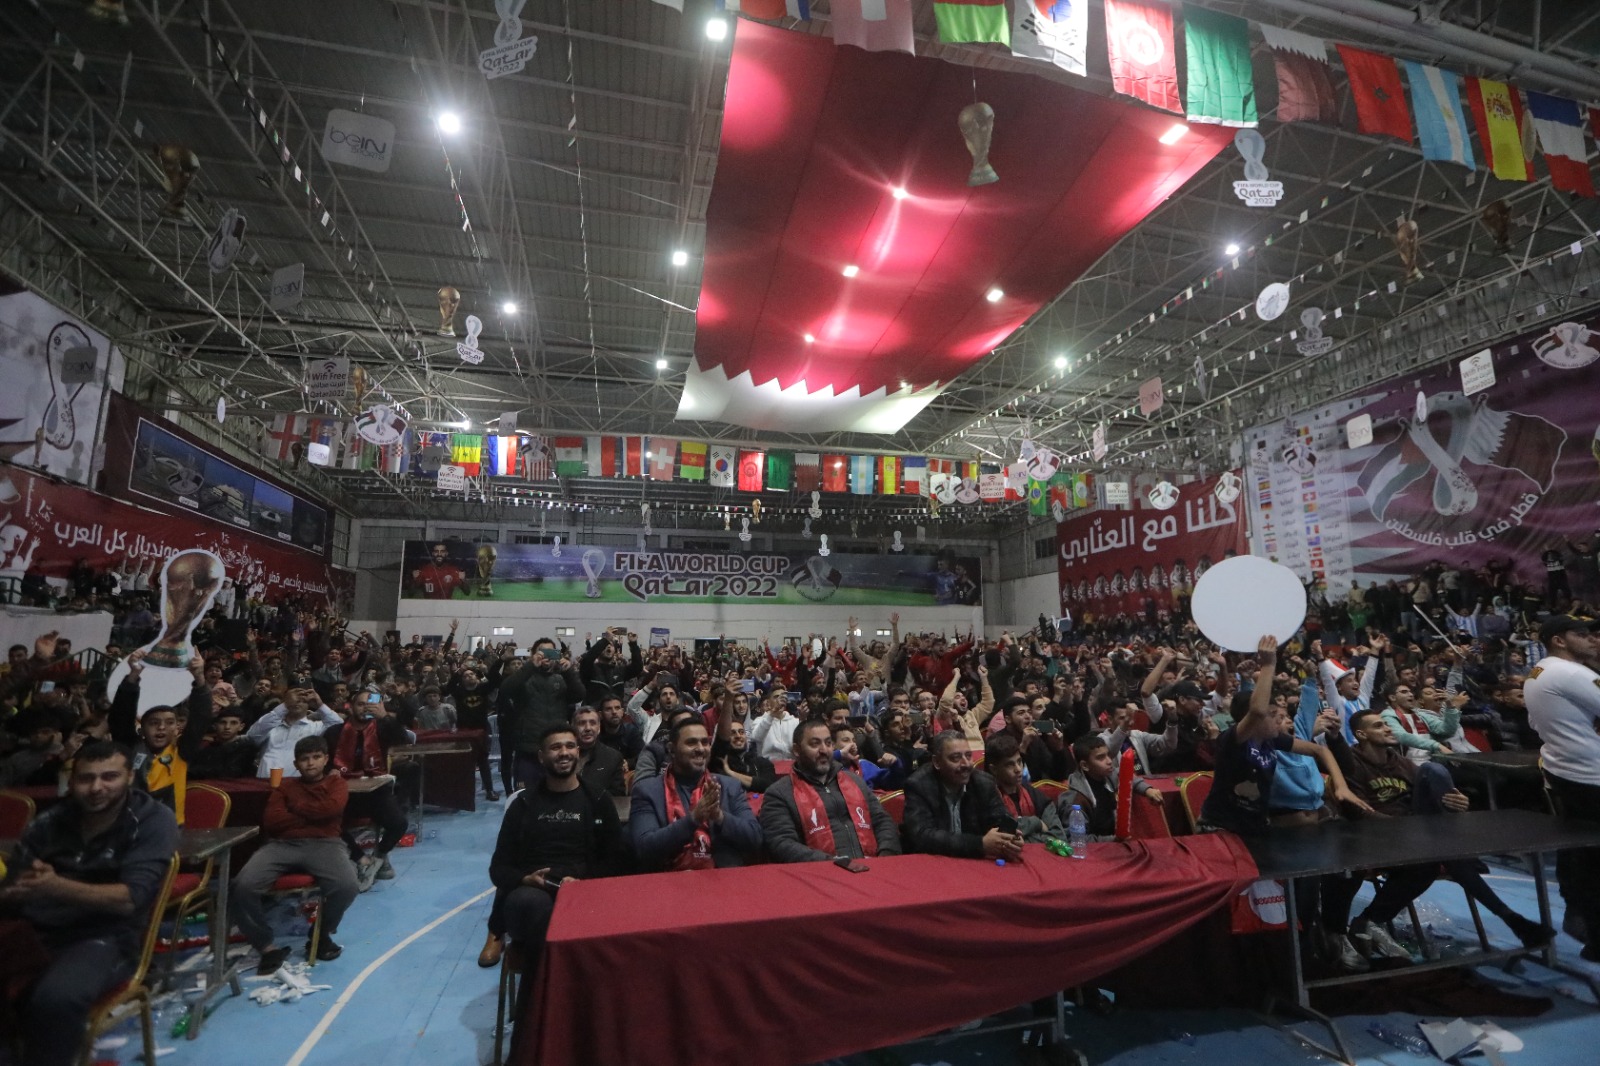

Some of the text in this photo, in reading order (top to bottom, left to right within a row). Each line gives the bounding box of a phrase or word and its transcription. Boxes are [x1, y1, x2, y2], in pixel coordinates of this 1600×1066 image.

[482, 48, 531, 71] Qatar
[496, 61, 520, 75] 2022
[330, 126, 387, 154] beIN
[1239, 188, 1281, 199] Qatar
[312, 372, 346, 380] Wifi Free
[1186, 494, 1237, 533] كلنا
[1385, 492, 1539, 549] قطر في قلب فلسطين
[54, 522, 103, 548] العرب
[104, 529, 128, 555] كل
[1142, 515, 1177, 551] مع
[615, 553, 789, 574] FIFA WORLD CUP
[425, 582, 434, 593] 10
